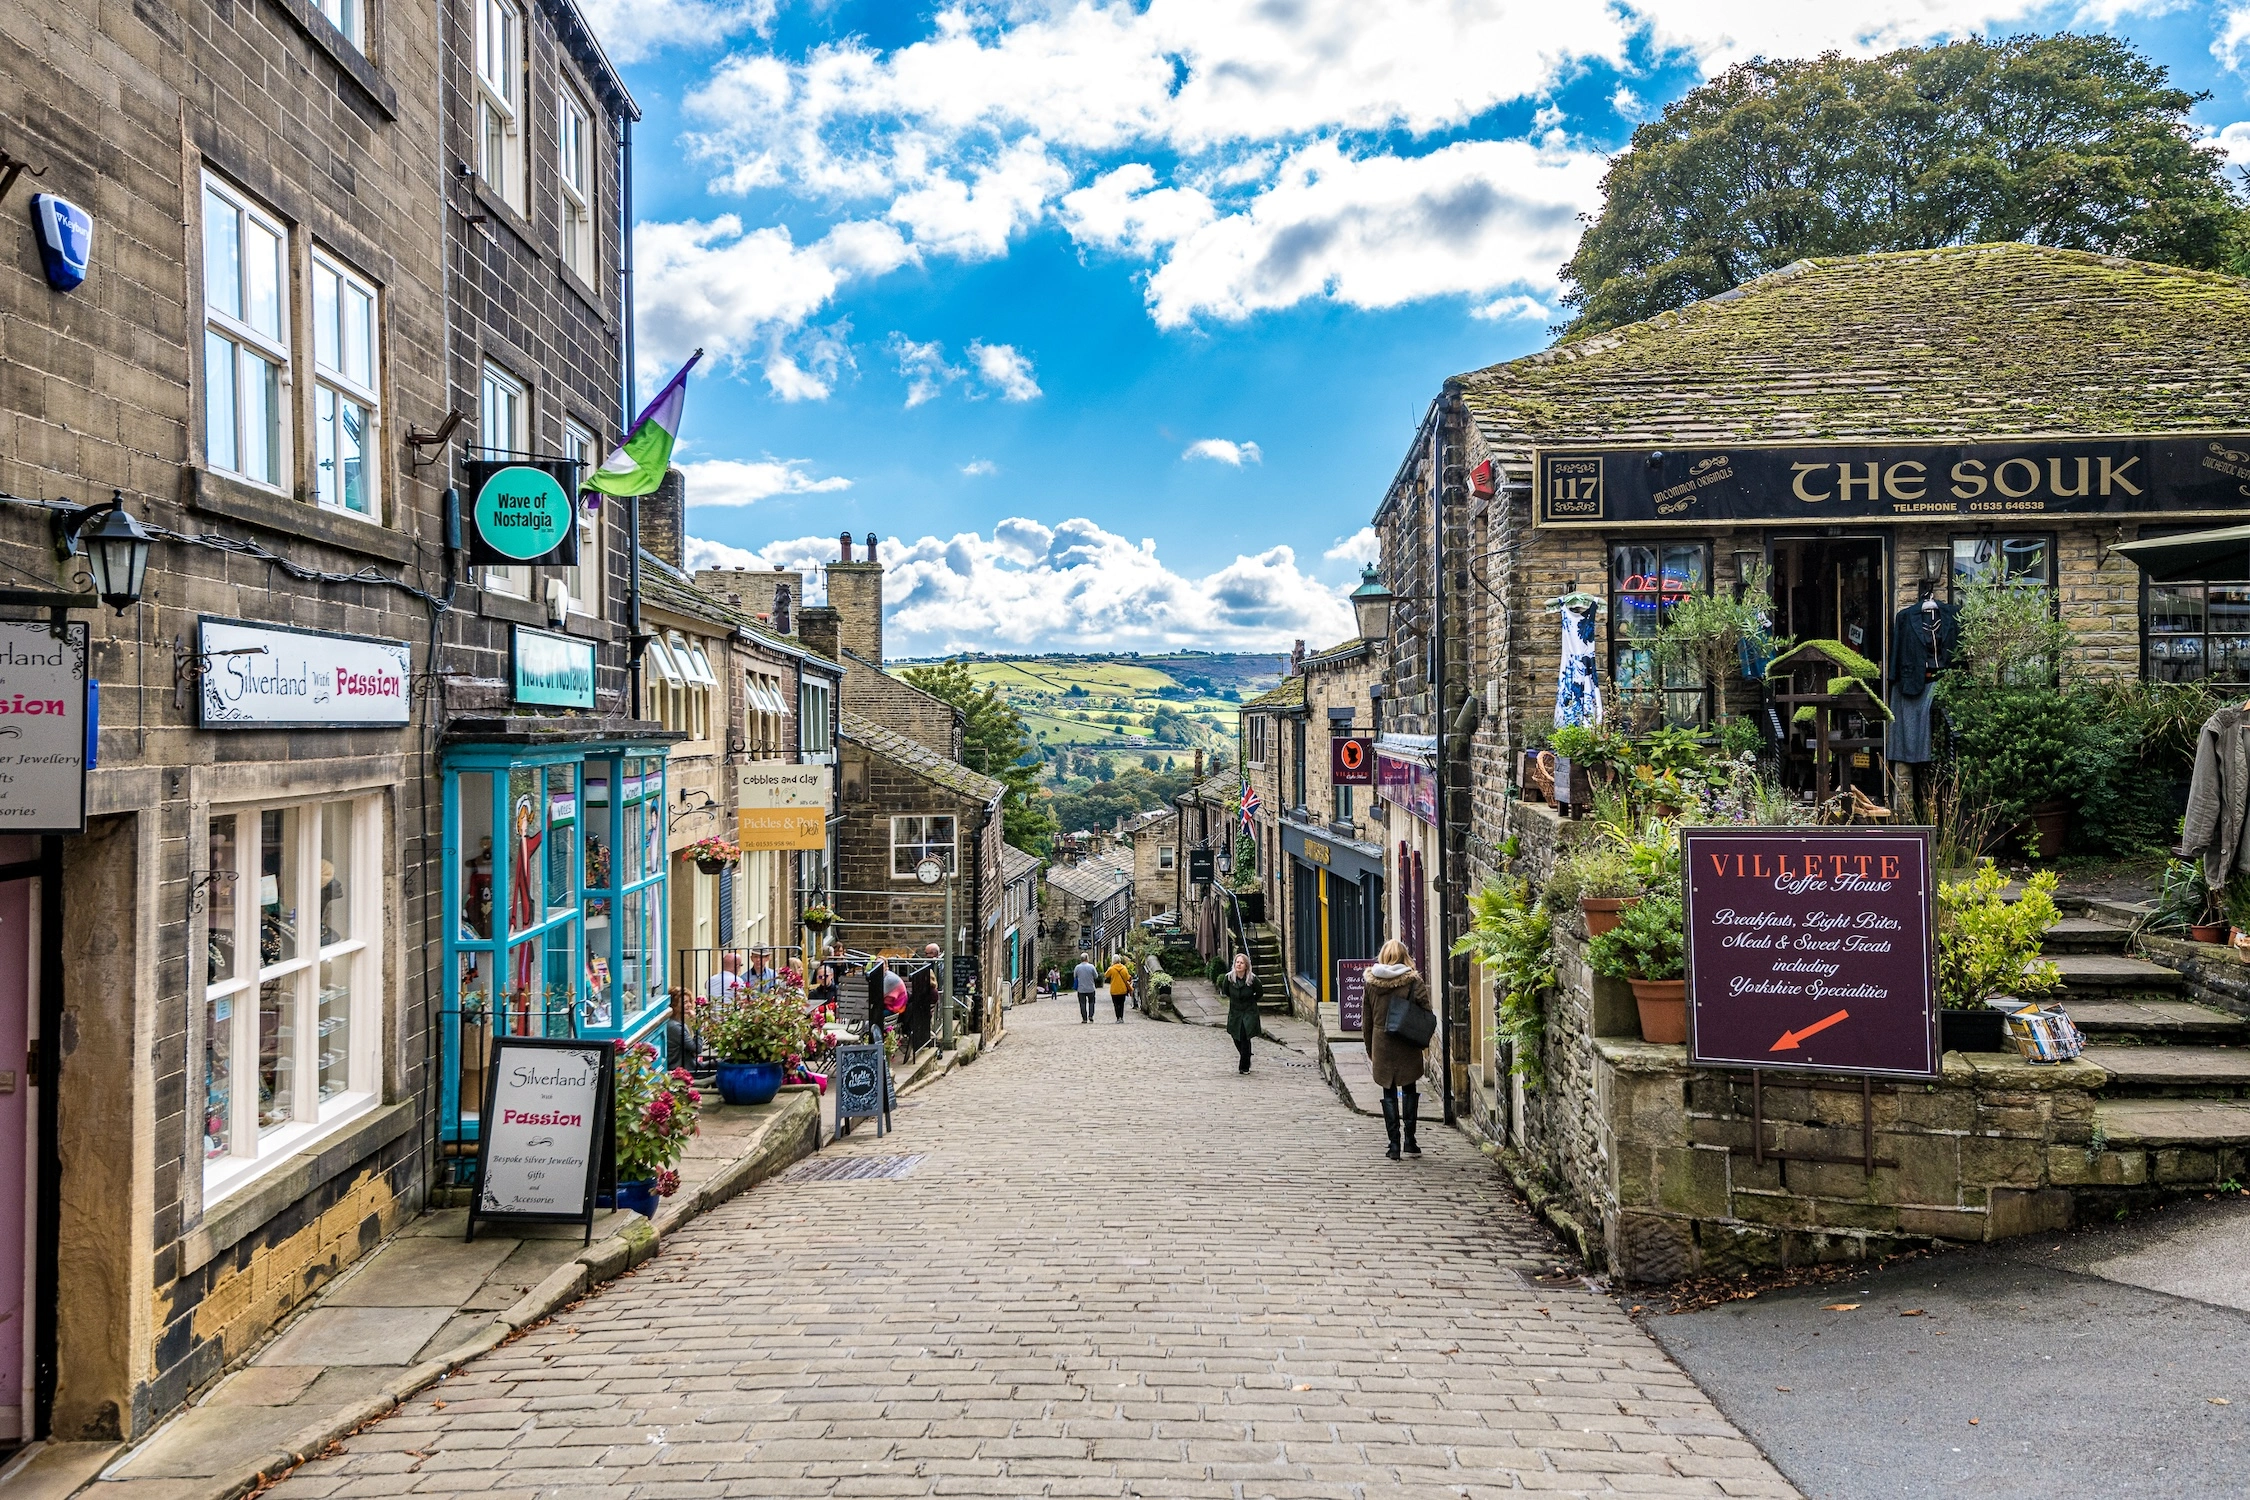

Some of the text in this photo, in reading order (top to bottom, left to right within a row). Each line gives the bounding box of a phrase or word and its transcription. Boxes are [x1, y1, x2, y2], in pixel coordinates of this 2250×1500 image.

[1696, 466, 1733, 488] ORIGINALS
[1790, 455, 2144, 503] THE SOUK
[1553, 477, 1598, 500] 117
[498, 492, 548, 509] Wave of
[1893, 500, 2045, 513] TELEPHONE 01535 646538
[493, 511, 552, 530] Nostalgia
[225, 655, 400, 701] Silverland With Passion
[16, 754, 80, 767] Jewellery
[781, 775, 797, 784] and
[743, 816, 820, 830] Pickles & Pots
[1710, 853, 1901, 880] VILLETTE
[1774, 871, 1892, 895] Coffee House
[1711, 908, 1902, 932] Breakfasts, Light Bites,
[1721, 932, 1892, 953] Meals & Sweet Treats
[1772, 958, 1840, 978] including
[1729, 975, 1888, 1001] Yorkshire Specialities
[509, 1066, 588, 1088] Silverland
[502, 1109, 582, 1128] Passion
[493, 1155, 584, 1168] Bespoke Silver Jewellery
[527, 1170, 546, 1180] Gifts
[511, 1195, 555, 1204] Accessories
